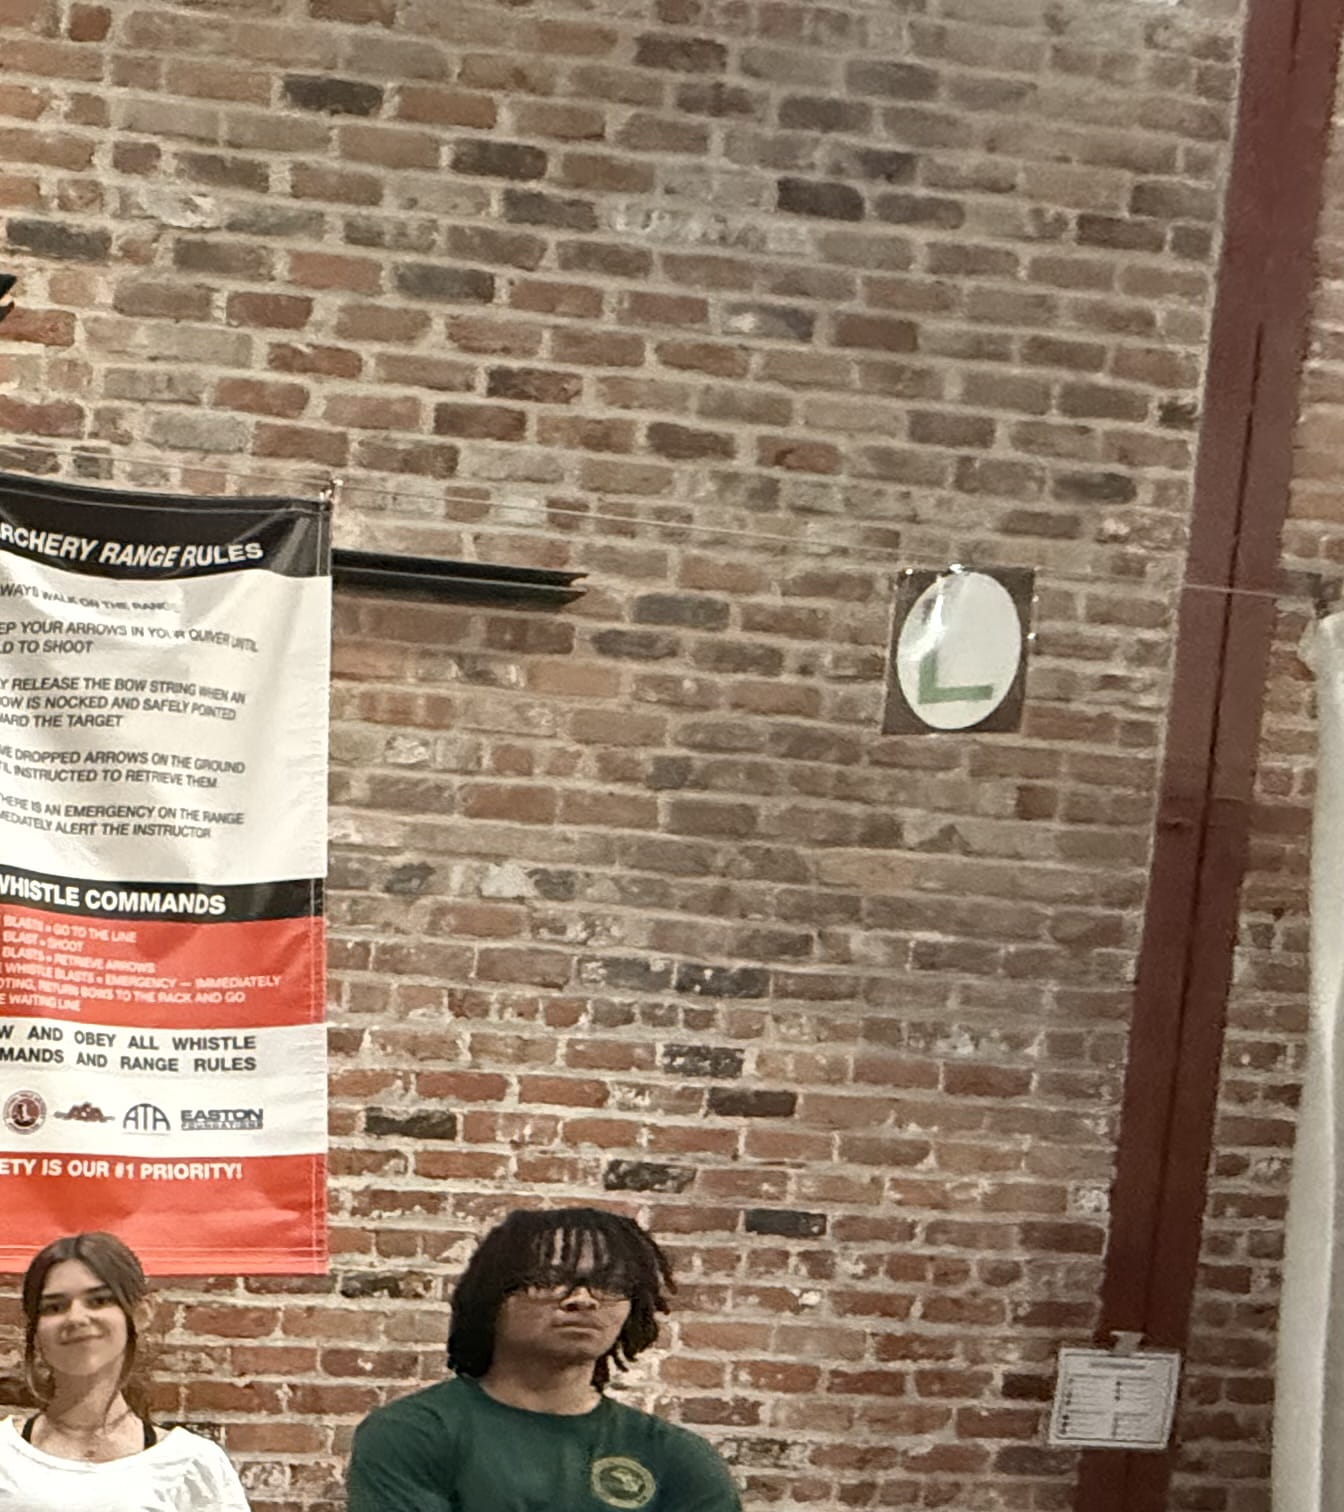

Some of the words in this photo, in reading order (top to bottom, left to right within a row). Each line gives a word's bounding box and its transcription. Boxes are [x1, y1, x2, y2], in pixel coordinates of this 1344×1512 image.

[99, 542, 180, 568] RANGE
[181, 542, 264, 568] RULES
[20, 621, 63, 634] YOUR
[65, 622, 127, 636] ARROWS
[131, 625, 144, 637] IN
[188, 628, 230, 645] QUIVER
[17, 640, 40, 653] TO
[42, 640, 94, 653] SHOOT
[12, 678, 79, 691] RELEASE
[83, 678, 111, 691] THE
[114, 678, 147, 692] BOW
[149, 681, 196, 697] STRING
[198, 685, 229, 701] WHEN
[230, 691, 246, 704] AN
[25, 696, 41, 709] IS
[44, 696, 109, 710] NOCKED
[112, 696, 140, 710] AND
[142, 698, 189, 714] SAFELY
[191, 702, 237, 720] POINTED
[34, 713, 62, 728] THE
[67, 713, 124, 727] TARGET
[14, 748, 80, 764] DROPPED
[83, 750, 149, 765] ARROWS
[151, 752, 169, 767] ON
[170, 755, 192, 770] THE
[194, 758, 245, 774] GROUND
[14, 765, 98, 782] INSTRUCTED
[102, 769, 123, 782] TO
[125, 770, 183, 786] RETRIEVE
[186, 775, 217, 788] THEM
[31, 801, 42, 813] IS
[44, 804, 62, 817] AN
[64, 805, 155, 819] EMERGENCY
[158, 807, 176, 820] ON
[179, 808, 200, 822] THE
[202, 810, 245, 825] RANGE
[55, 821, 96, 835] ALERT
[101, 822, 129, 835] THE
[133, 823, 211, 839] INSTRUCTOR
[85, 889, 226, 915] COMMANDS
[71, 926, 87, 937] TO
[5, 963, 53, 979] WHISTLE
[114, 988, 132, 1002] TO
[196, 992, 222, 1003] AND
[224, 991, 245, 1002] GO
[27, 1026, 63, 1041] AND
[74, 1030, 116, 1048] OBEY
[128, 1036, 159, 1051] ALL
[172, 1035, 257, 1050] WHISTLE
[76, 1052, 108, 1068] AND
[120, 1056, 179, 1072] RANGE
[193, 1057, 257, 1072] RULES
[123, 1103, 171, 1131] ATA
[180, 1108, 263, 1121] EASTON
[41, 1159, 63, 1175] IS
[67, 1159, 110, 1177] OUR
[115, 1160, 134, 1179] #1
[140, 1162, 243, 1180] PRIORITY!
